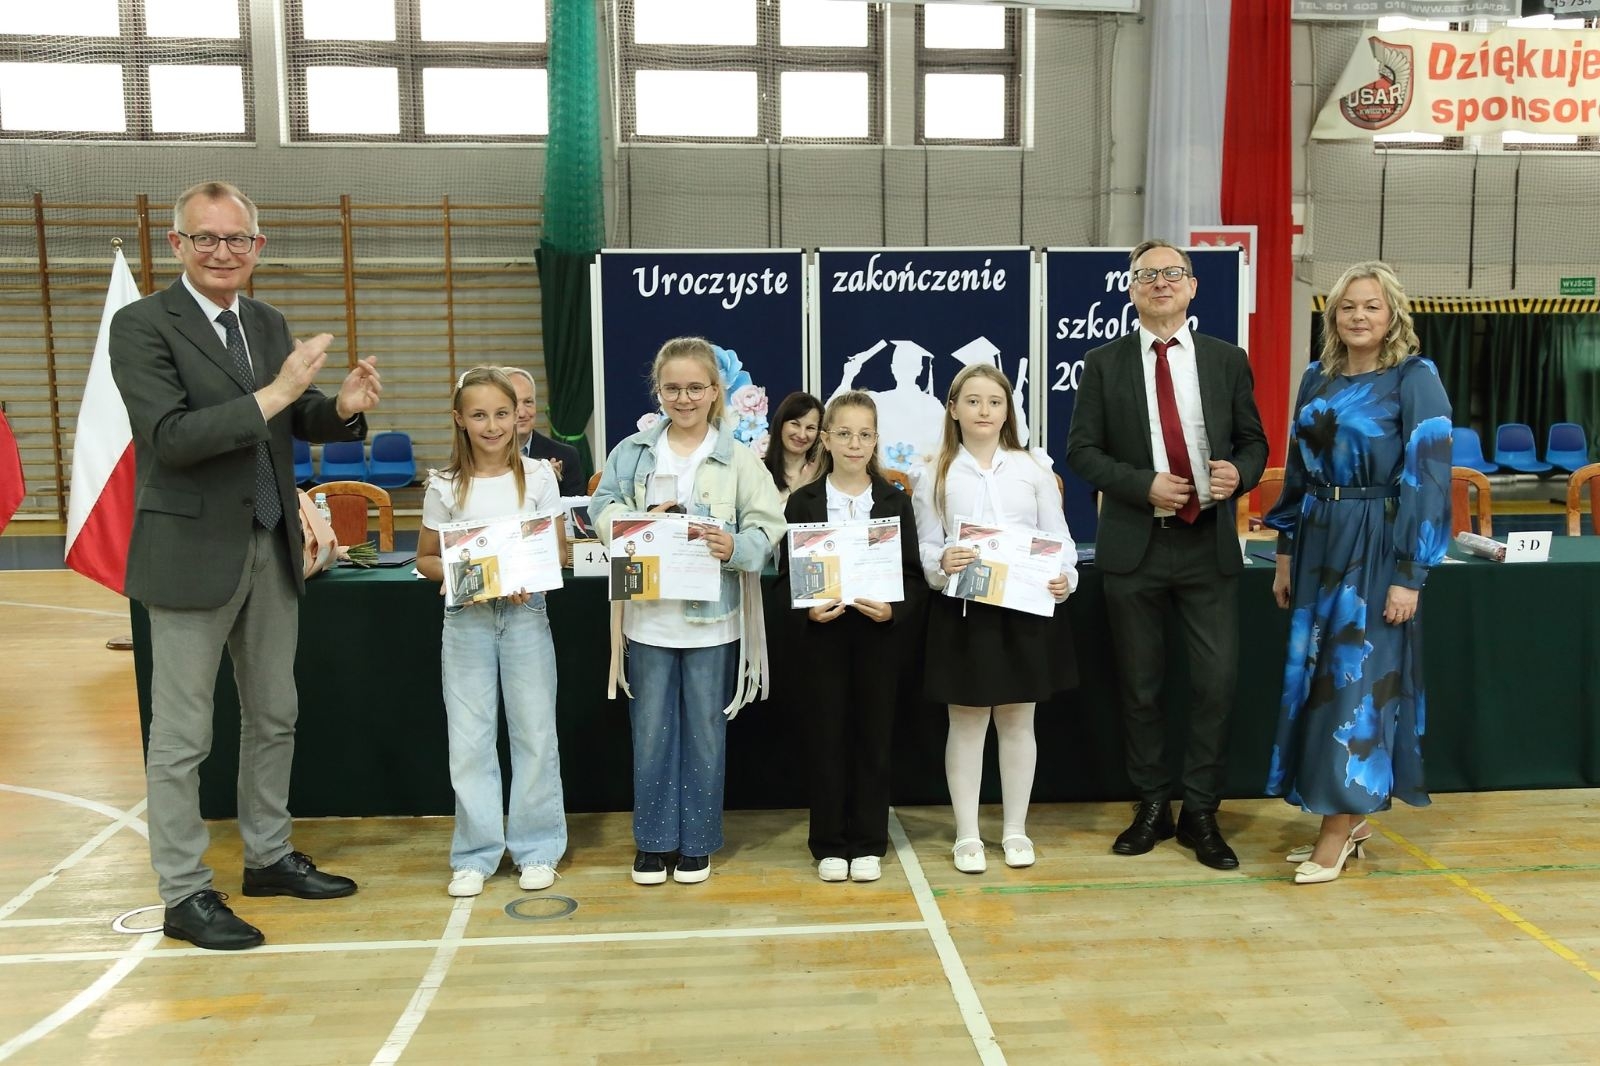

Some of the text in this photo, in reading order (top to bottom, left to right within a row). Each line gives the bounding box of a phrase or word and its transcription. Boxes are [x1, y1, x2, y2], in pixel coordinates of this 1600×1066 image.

[1326, 2, 1348, 11] 501
[1353, 2, 1378, 11] 403
[1428, 39, 1600, 87] Dziękuje
[1347, 83, 1403, 107] USAR
[1431, 96, 1600, 131] sponsor
[832, 253, 1007, 293] zakończenie
[1105, 270, 1132, 293] ro
[632, 265, 789, 310] Uroczyste
[585, 551, 610, 563] 4 A
[1517, 539, 1540, 551] 3 D
